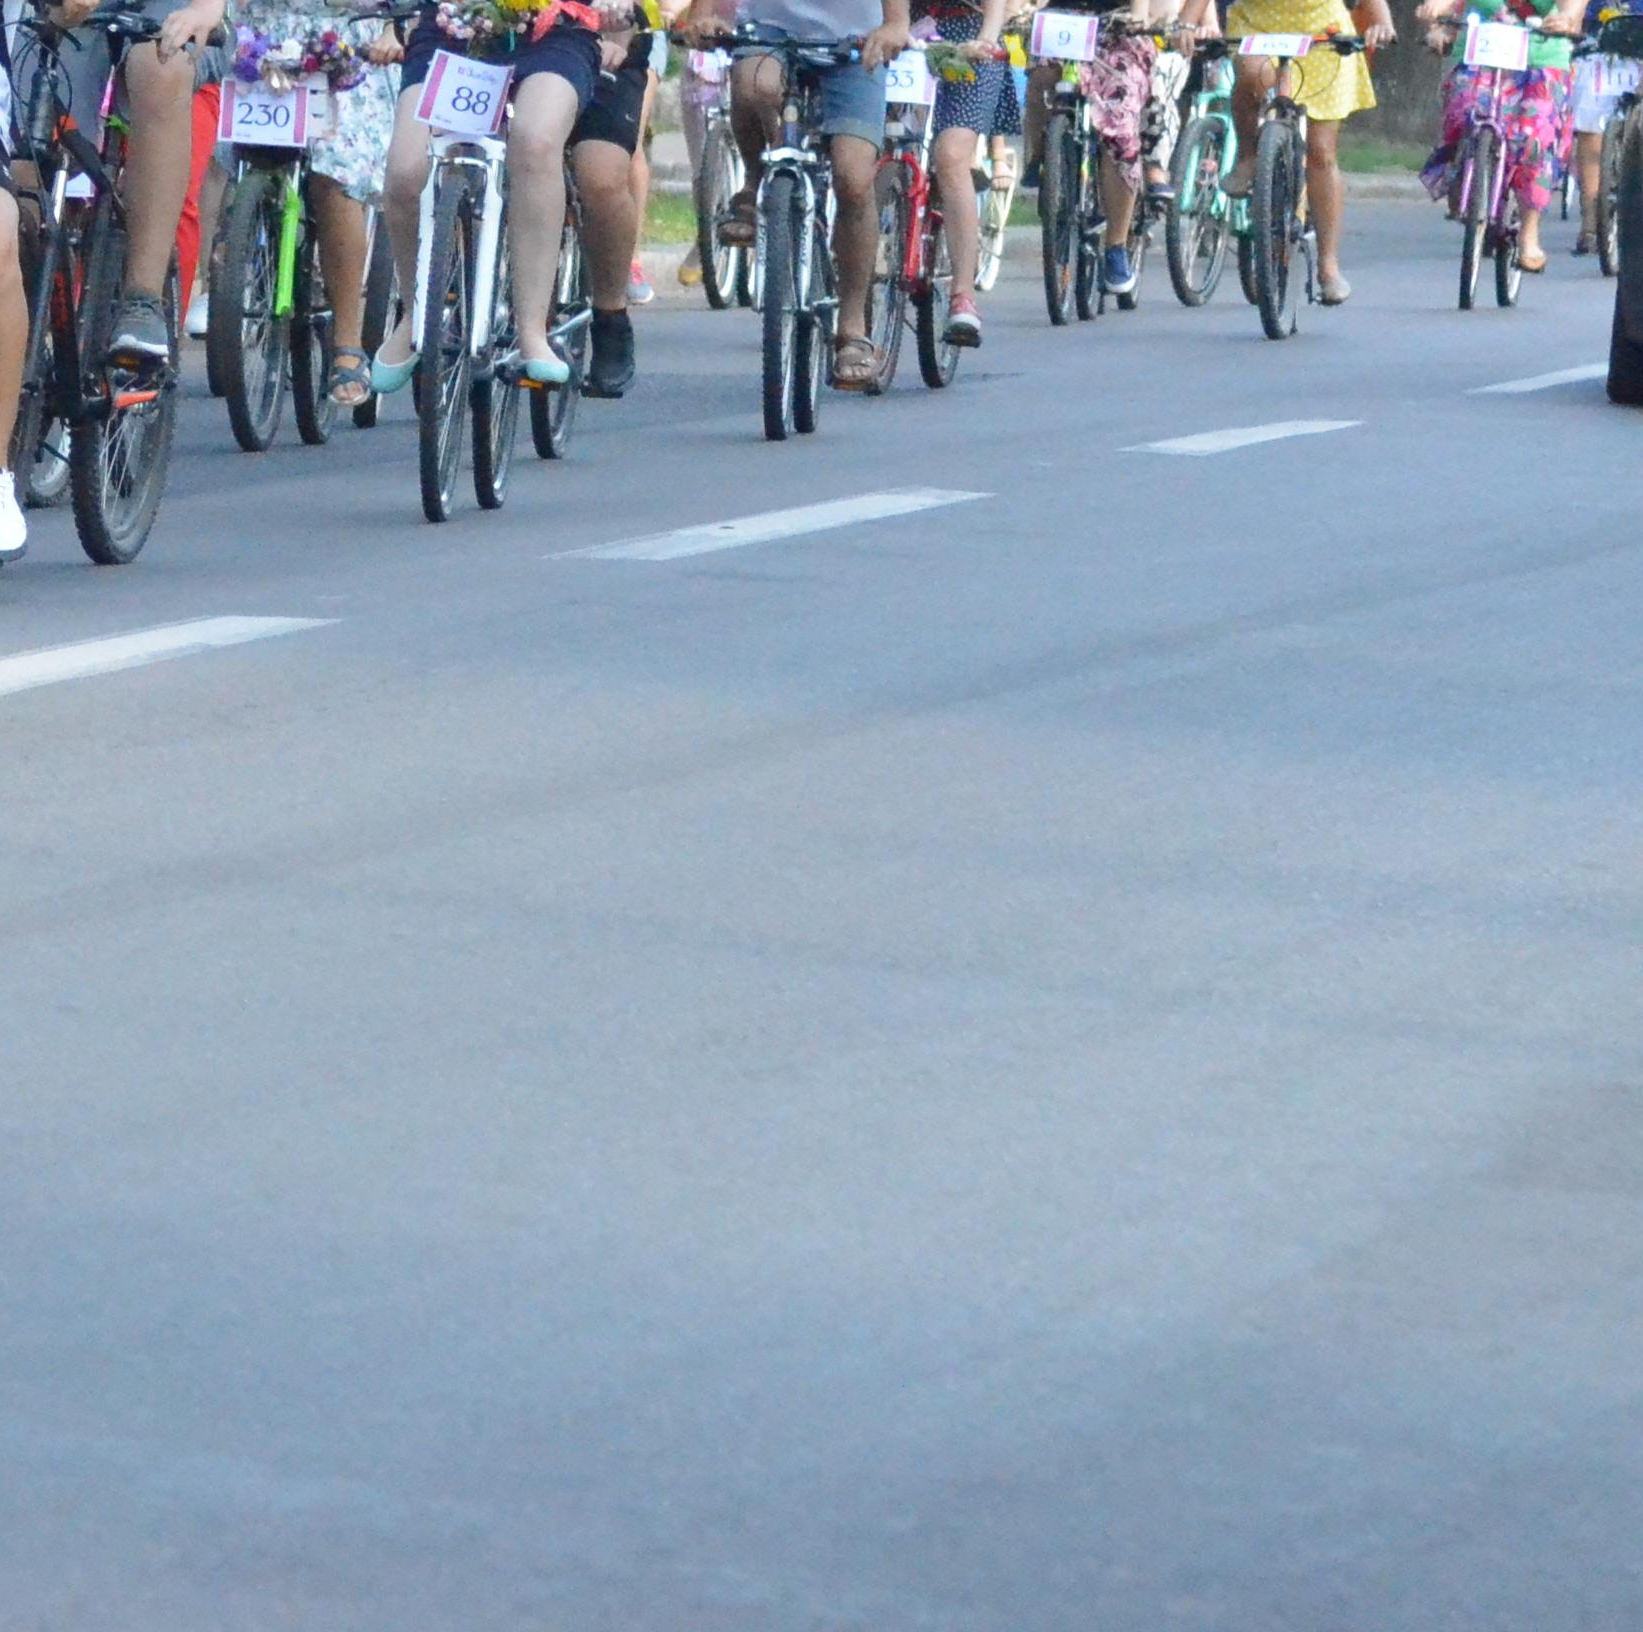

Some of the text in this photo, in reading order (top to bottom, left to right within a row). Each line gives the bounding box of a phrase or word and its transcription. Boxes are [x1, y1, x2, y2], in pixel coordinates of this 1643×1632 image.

[1058, 30, 1071, 46] 9
[451, 86, 491, 116] 88
[237, 102, 290, 128] 230
